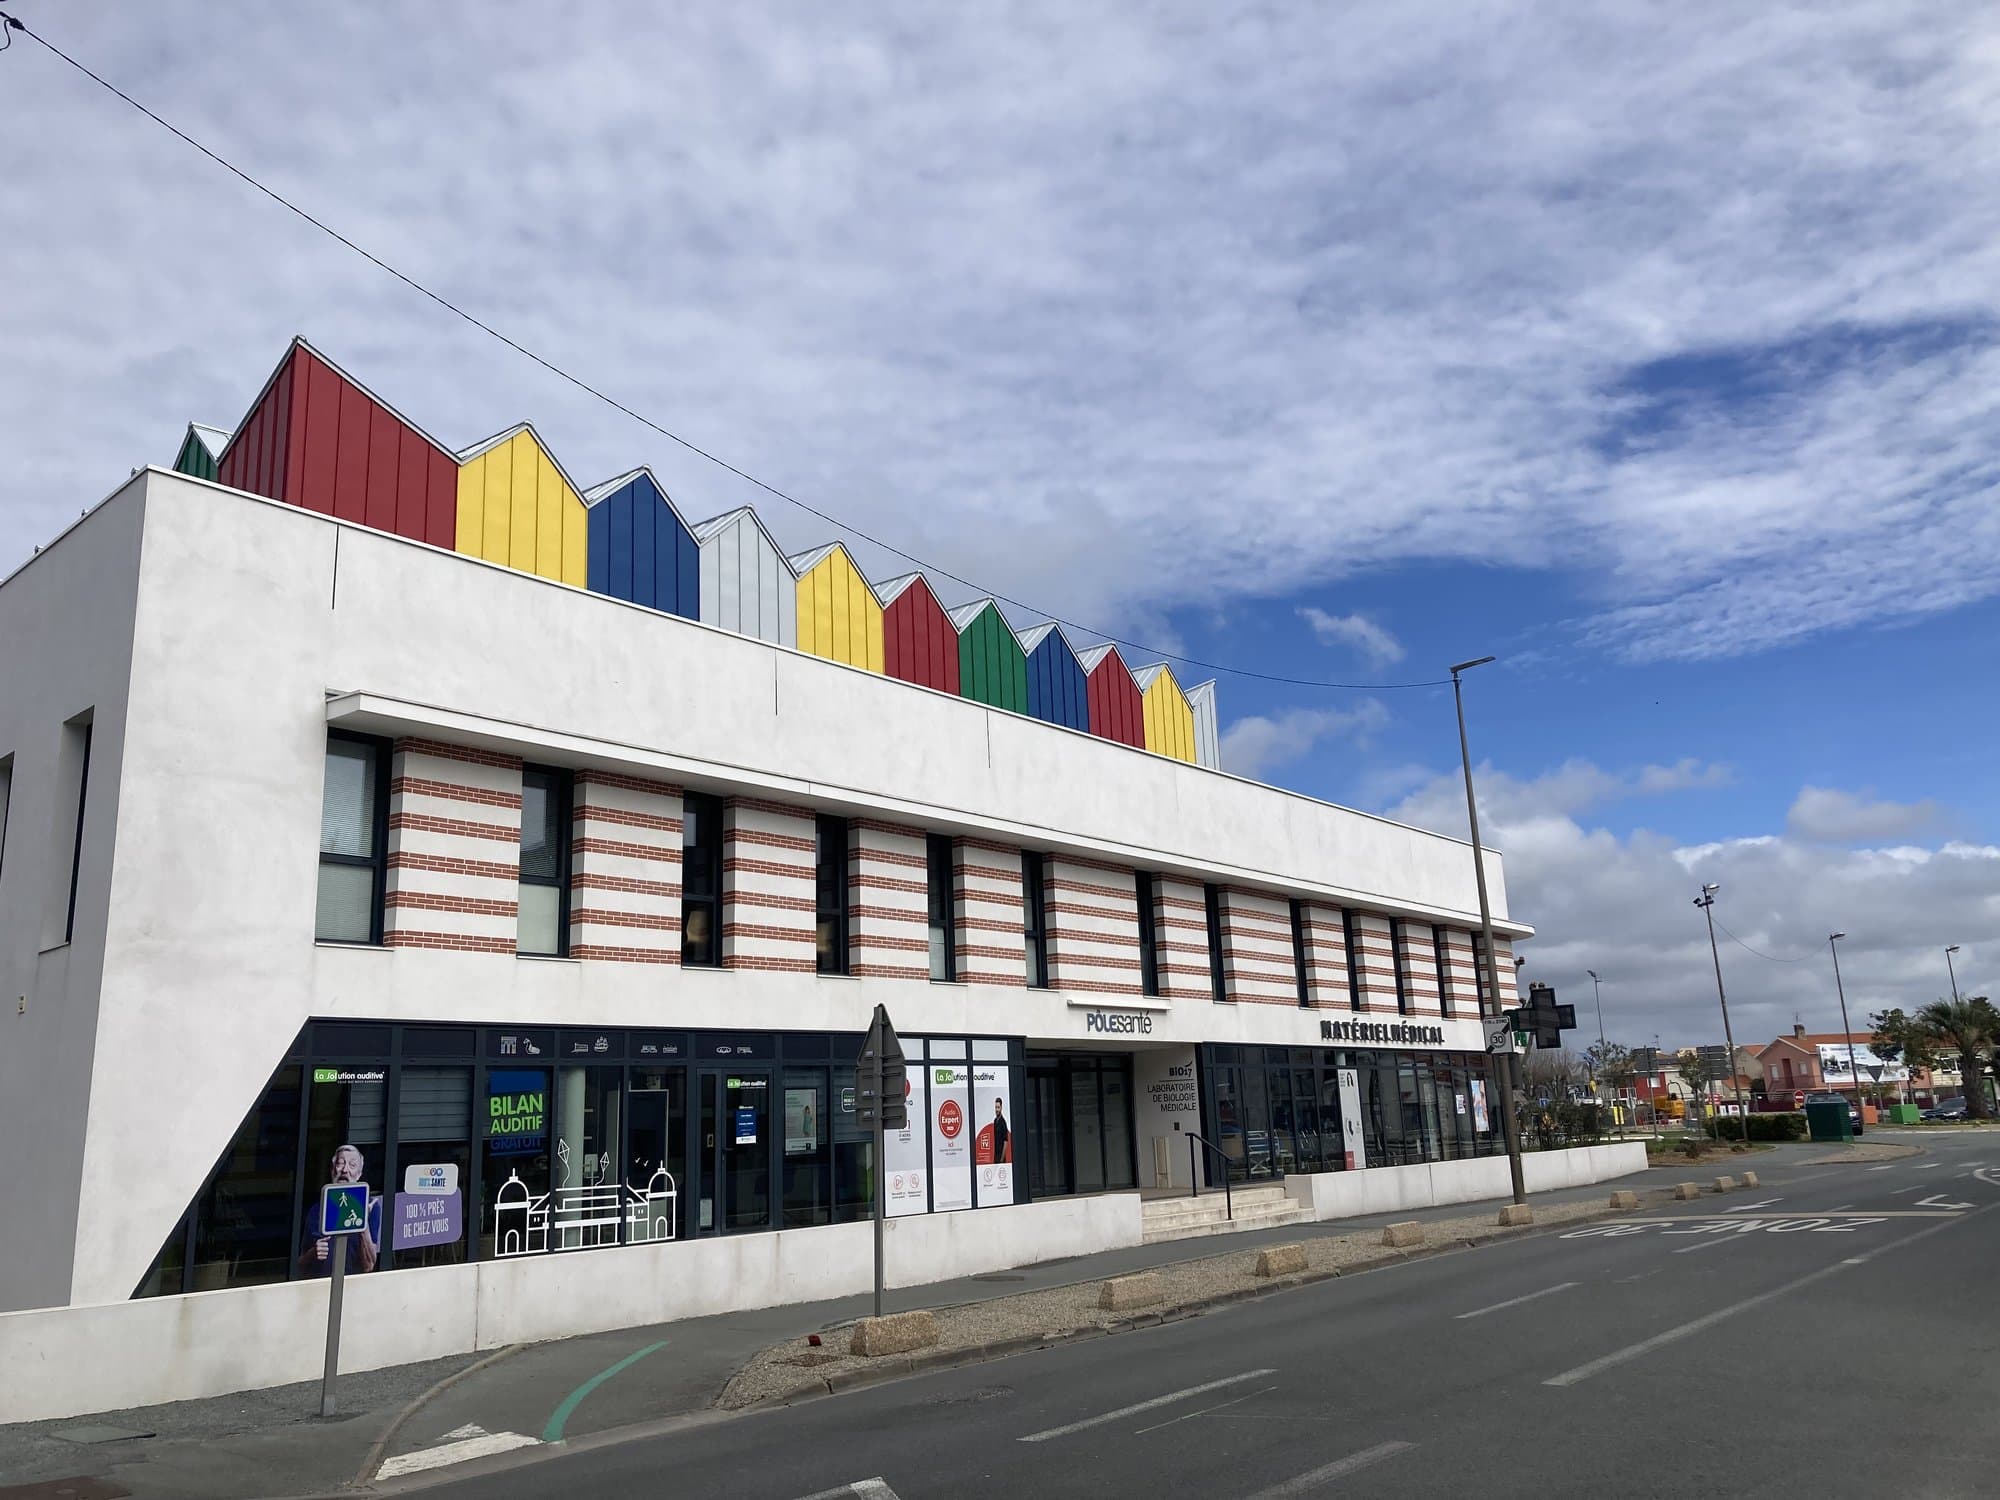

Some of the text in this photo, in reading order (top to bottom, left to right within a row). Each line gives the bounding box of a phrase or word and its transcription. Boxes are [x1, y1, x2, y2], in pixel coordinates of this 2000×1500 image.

[315, 1071, 384, 1080] La Solution auditive
[936, 1072, 994, 1081] La Solution auditive
[1147, 1083, 1195, 1093] LABORATOIRE
[1163, 1093, 1196, 1102] BIOLOGIE
[490, 1094, 543, 1116] BILAN
[490, 1116, 543, 1134] AUDITIF
[942, 1116, 959, 1124] Expert
[406, 1204, 418, 1219] 100
[428, 1198, 445, 1216] PRÈS
[403, 1218, 449, 1238] DE CHEZ VOUS
[1661, 1218, 1888, 1233] ZONE
